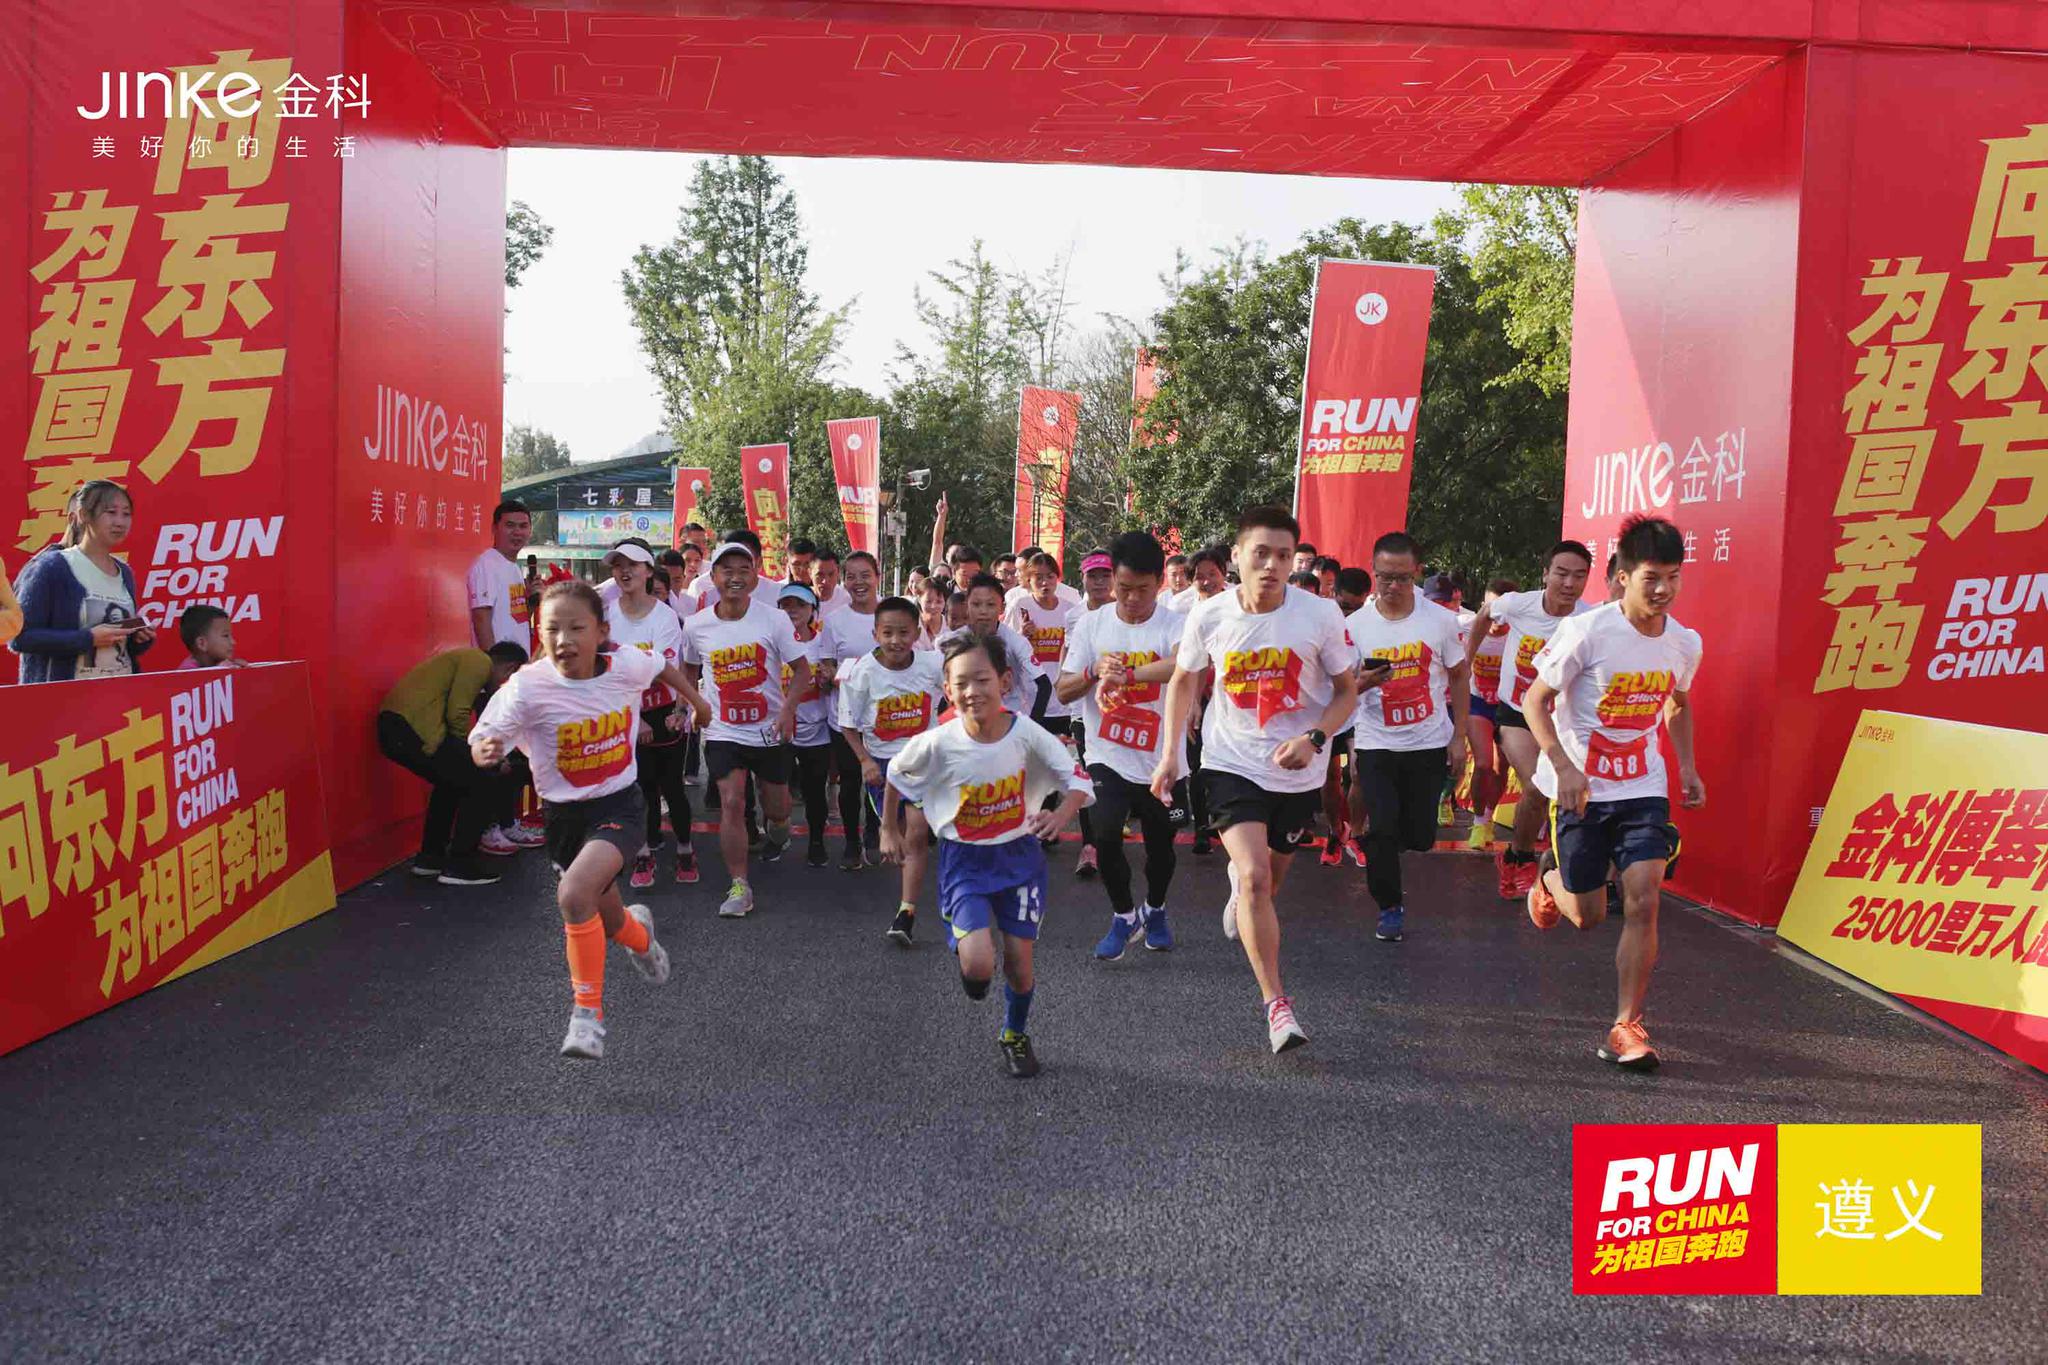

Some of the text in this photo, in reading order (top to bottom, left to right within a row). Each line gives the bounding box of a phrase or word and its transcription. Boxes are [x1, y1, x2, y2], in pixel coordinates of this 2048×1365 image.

[1310, 397, 1417, 435] RUN
[451, 414, 488, 481] 金科
[1306, 435, 1406, 452] FOR CHINA
[1679, 427, 1747, 504] 金科
[1814, 256, 1950, 694] 为祖国奔跑
[370, 487, 482, 535] 美好你的生活
[151, 516, 284, 566] RUN
[142, 565, 228, 599] FOR
[1935, 618, 2017, 650] FOR
[709, 642, 757, 666] RUN
[1223, 646, 1290, 673] RUN
[1927, 646, 2045, 681] CHINA
[1608, 671, 1673, 693] RUN
[170, 674, 234, 747] RUN
[556, 705, 628, 746] RUN
[728, 707, 760, 721] 019
[890, 709, 922, 720] CHINA
[1392, 703, 1427, 723] 003
[582, 731, 627, 756] CHINA
[1108, 722, 1149, 747] 096
[173, 738, 217, 788] FOR
[1597, 755, 1638, 777] 068
[176, 767, 239, 830] CHINA
[960, 769, 1025, 806] RUN
[979, 796, 1022, 816] CHINA
[1823, 788, 2048, 890] 金科博翠
[92, 787, 288, 999] 为祖国奔跑
[1831, 894, 2048, 968] 25000里万人
